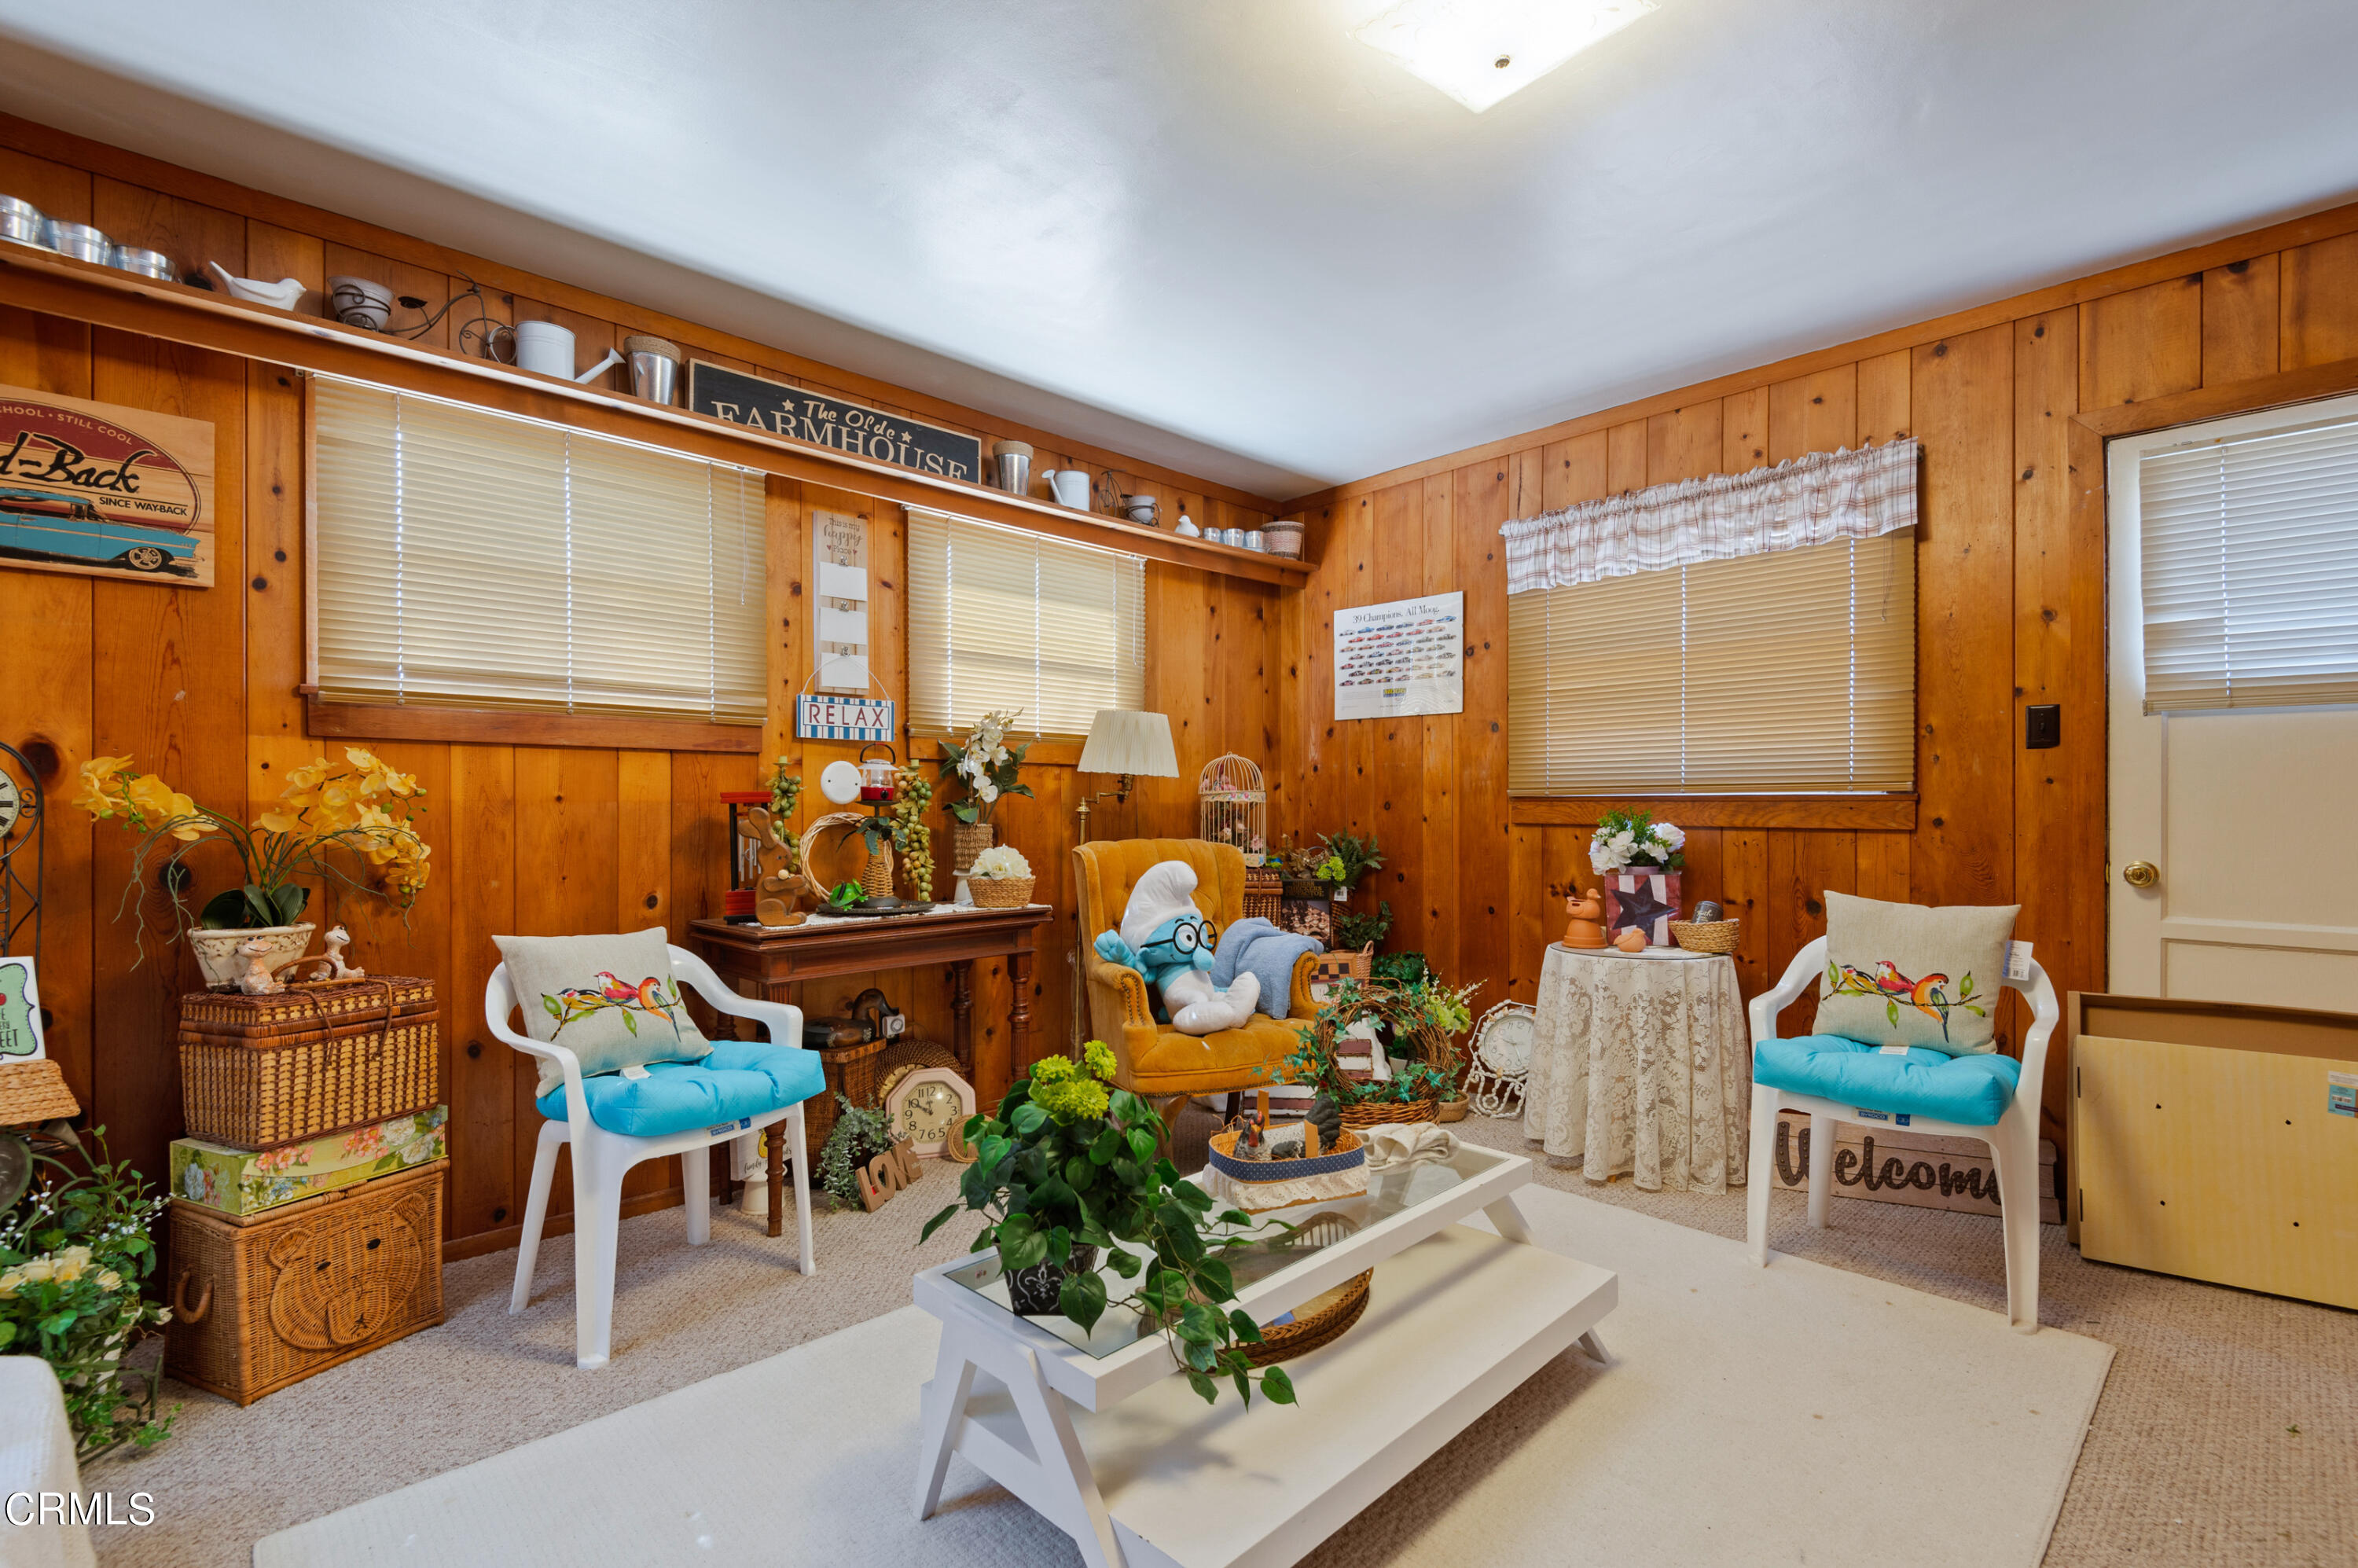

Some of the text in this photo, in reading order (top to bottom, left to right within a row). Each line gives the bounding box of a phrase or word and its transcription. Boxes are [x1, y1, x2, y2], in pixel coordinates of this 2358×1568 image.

[803, 400, 895, 439] The Olde
[57, 413, 93, 430] STILL
[97, 425, 133, 446] COOL
[99, 497, 188, 516] SINCE WAY-BACK
[828, 517, 842, 527] This
[849, 523, 860, 532] my
[824, 524, 863, 547] happy
[1353, 604, 1440, 623] 39 Champions. All Moog.
[809, 703, 884, 728] RELAX
[918, 1089, 924, 1098] 11
[927, 1086, 936, 1096] 12
[909, 1098, 919, 1108] 10
[946, 1094, 953, 1104] 2
[905, 1109, 913, 1120] 9
[950, 1106, 957, 1116] 3
[909, 1121, 916, 1131] 8
[946, 1118, 953, 1126] 4
[919, 1129, 925, 1139] 7
[927, 1129, 936, 1140] 6
[938, 1127, 946, 1138] 5
[855, 1137, 924, 1214] LOVE
